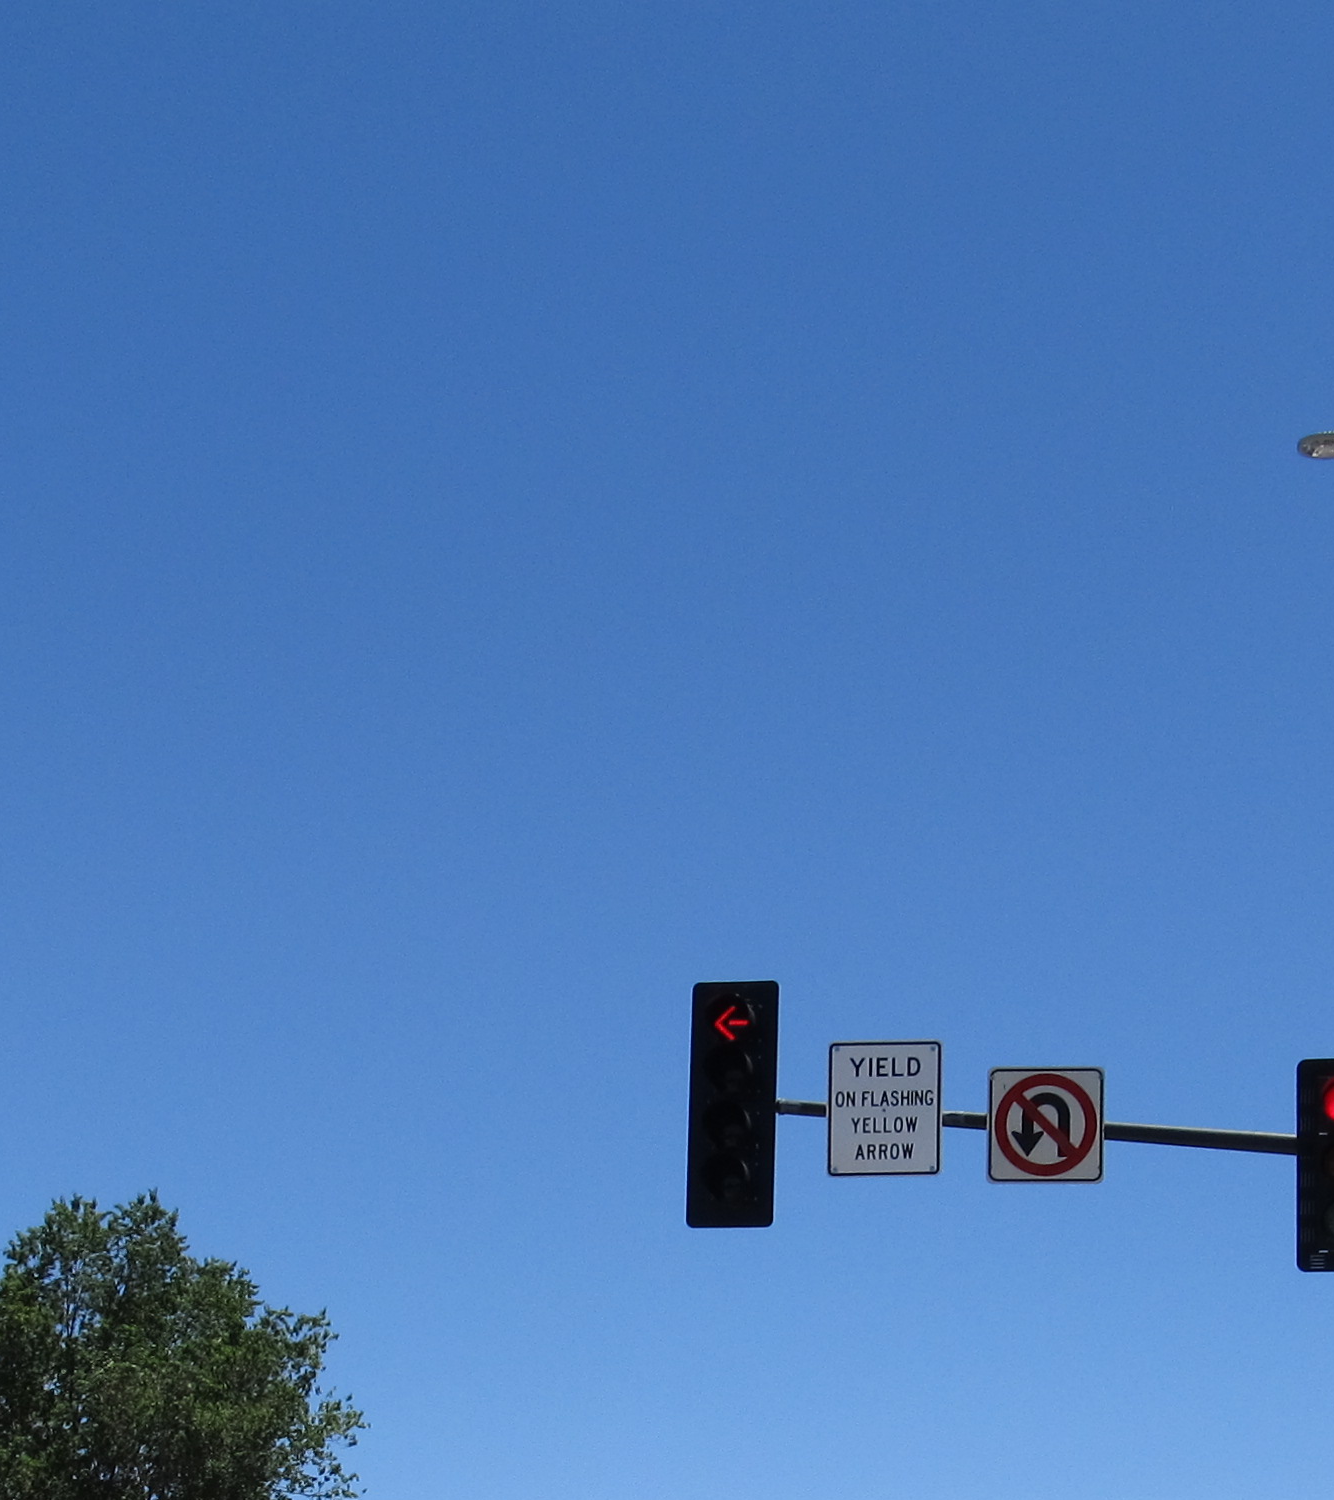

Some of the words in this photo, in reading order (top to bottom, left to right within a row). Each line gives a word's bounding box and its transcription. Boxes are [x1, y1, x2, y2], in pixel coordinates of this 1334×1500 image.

[850, 1057, 921, 1077] YIELD
[835, 1091, 856, 1108] ON
[862, 1089, 934, 1107] FLASHING
[851, 1116, 918, 1134] YELLOW
[855, 1143, 914, 1160] ARROW
